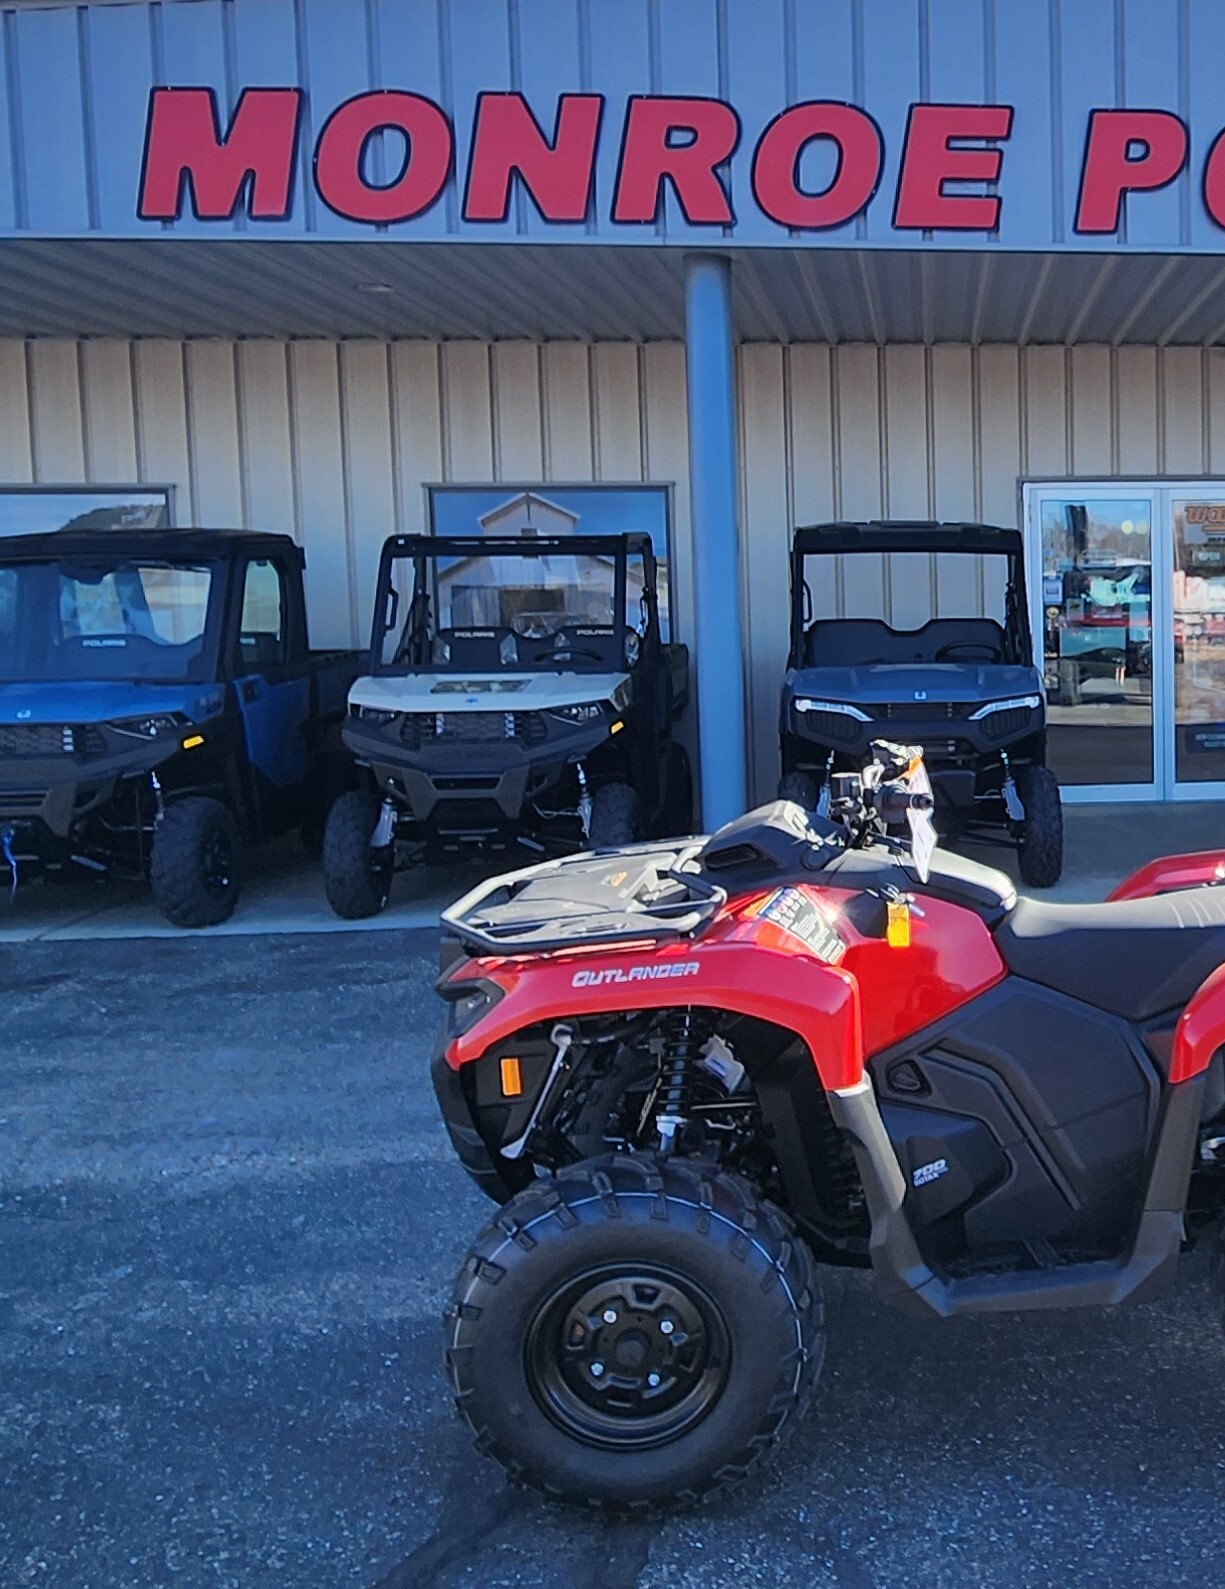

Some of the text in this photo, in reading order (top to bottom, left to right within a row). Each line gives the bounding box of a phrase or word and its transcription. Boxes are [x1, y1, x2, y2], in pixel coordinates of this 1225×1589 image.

[138, 87, 1014, 231] MONROE
[82, 639, 126, 648] POLARIS
[454, 631, 496, 639] POLARIS
[571, 962, 700, 988] OUTLANDER
[913, 1159, 946, 1180] 700
